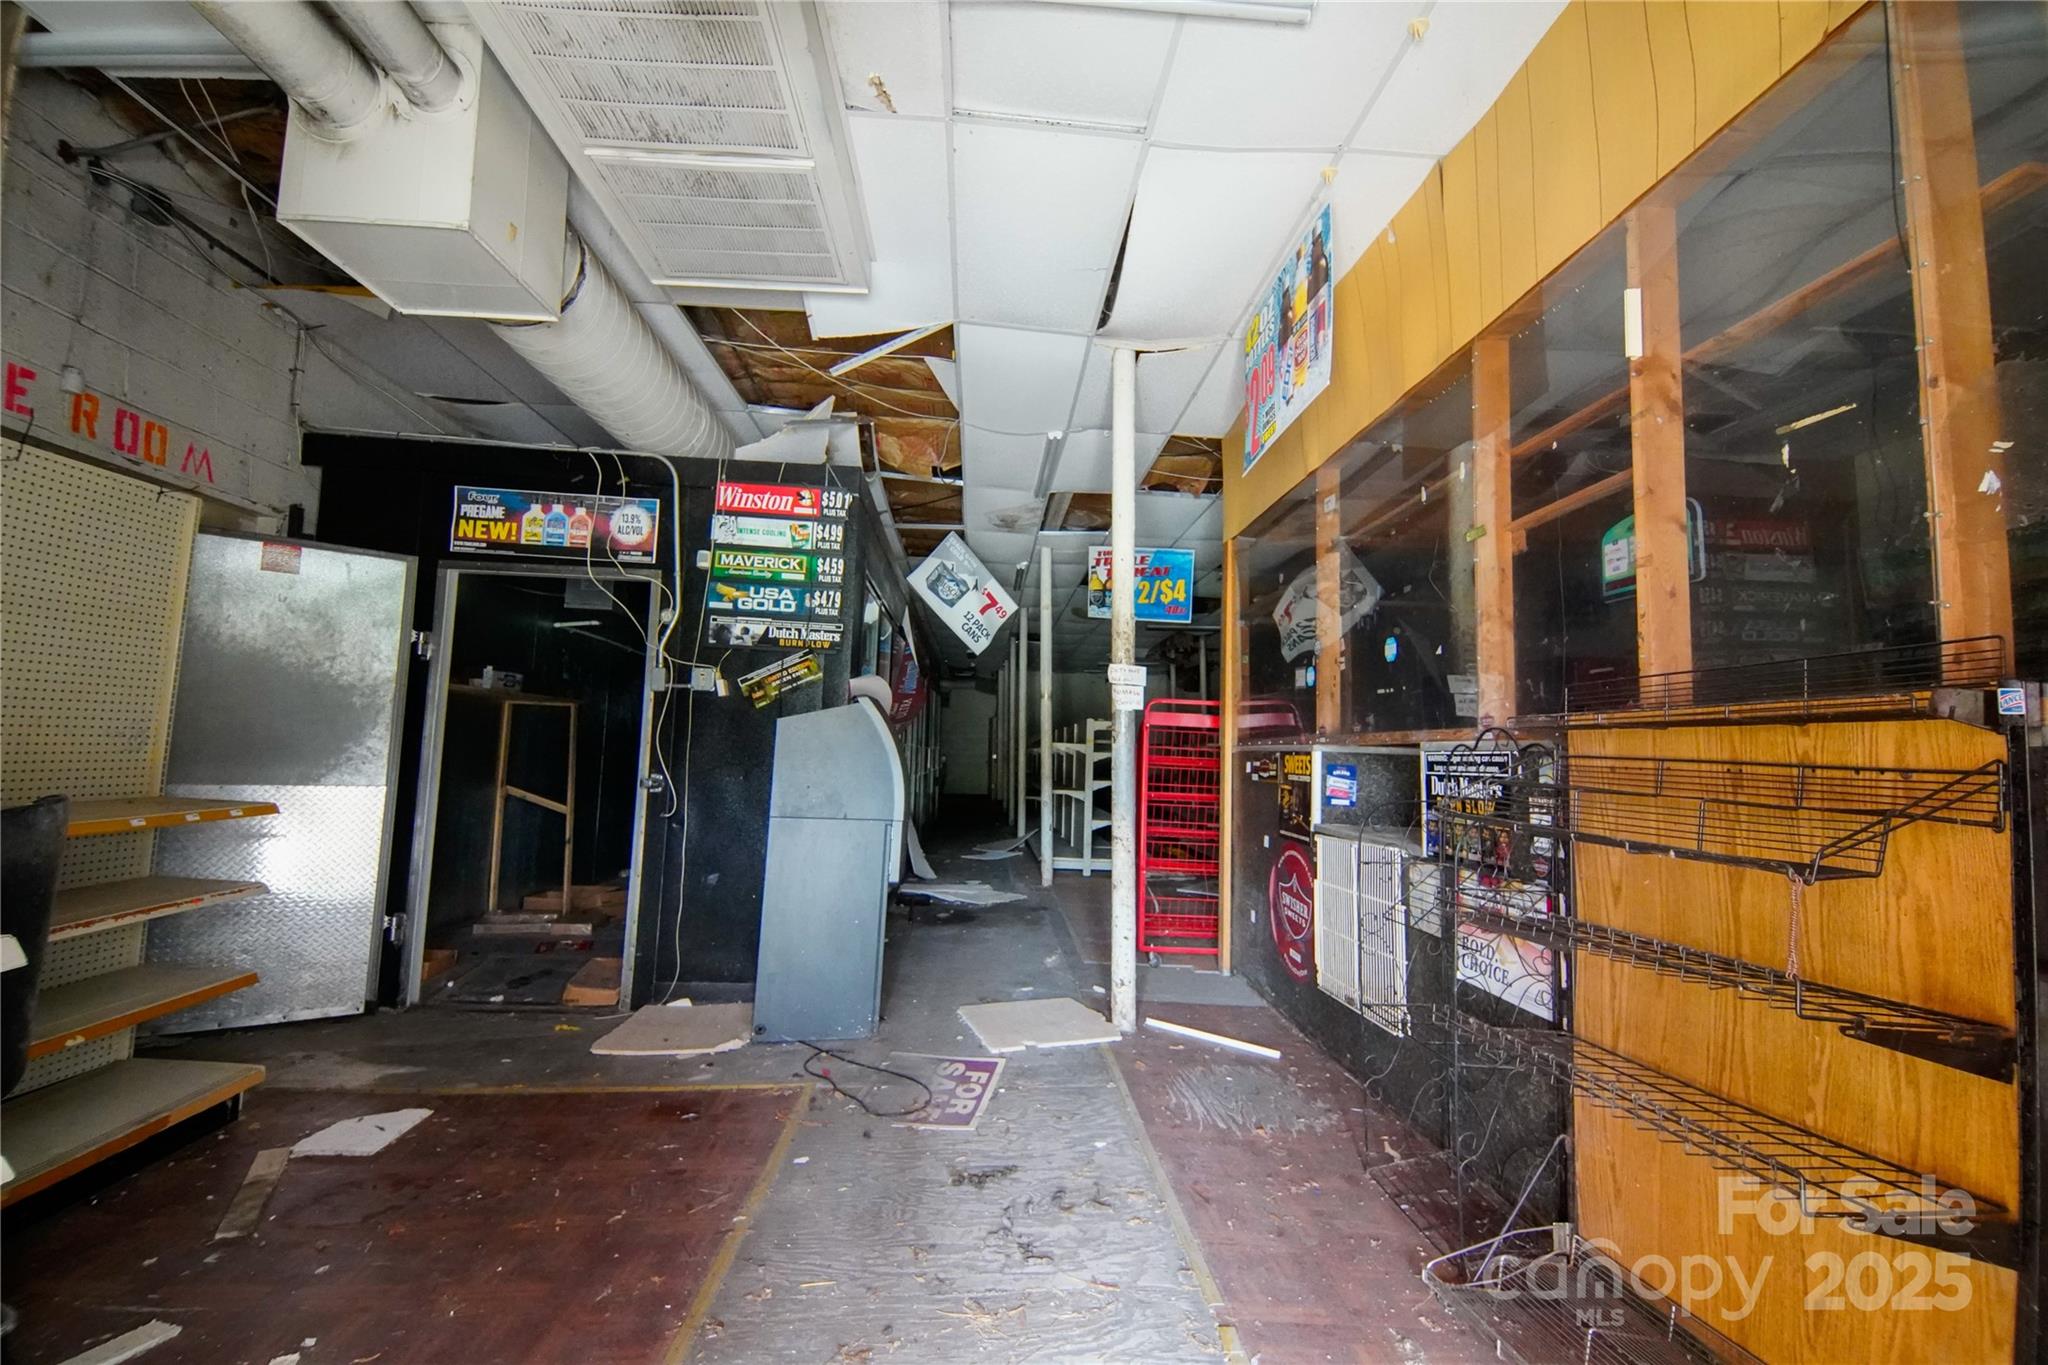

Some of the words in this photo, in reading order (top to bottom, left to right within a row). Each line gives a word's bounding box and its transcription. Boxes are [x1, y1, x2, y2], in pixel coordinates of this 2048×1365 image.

[71, 390, 214, 484] ROOM
[719, 485, 794, 512] Winston
[460, 503, 505, 519] PREGAME
[458, 519, 518, 541] NEW!
[830, 542, 841, 551] TAX
[720, 553, 800, 570] MAVERICK
[831, 575, 842, 583] TAX
[748, 586, 794, 600] USA
[1137, 578, 1187, 604] 2/$4
[737, 597, 797, 613] GOLD
[828, 608, 839, 617] TAX
[768, 625, 799, 640] Dutch
[961, 622, 982, 644] CANS
[962, 611, 975, 622] 12
[971, 619, 992, 640] PACK
[1284, 754, 1311, 775] SWEETS
[944, 1071, 991, 1115] FOR
